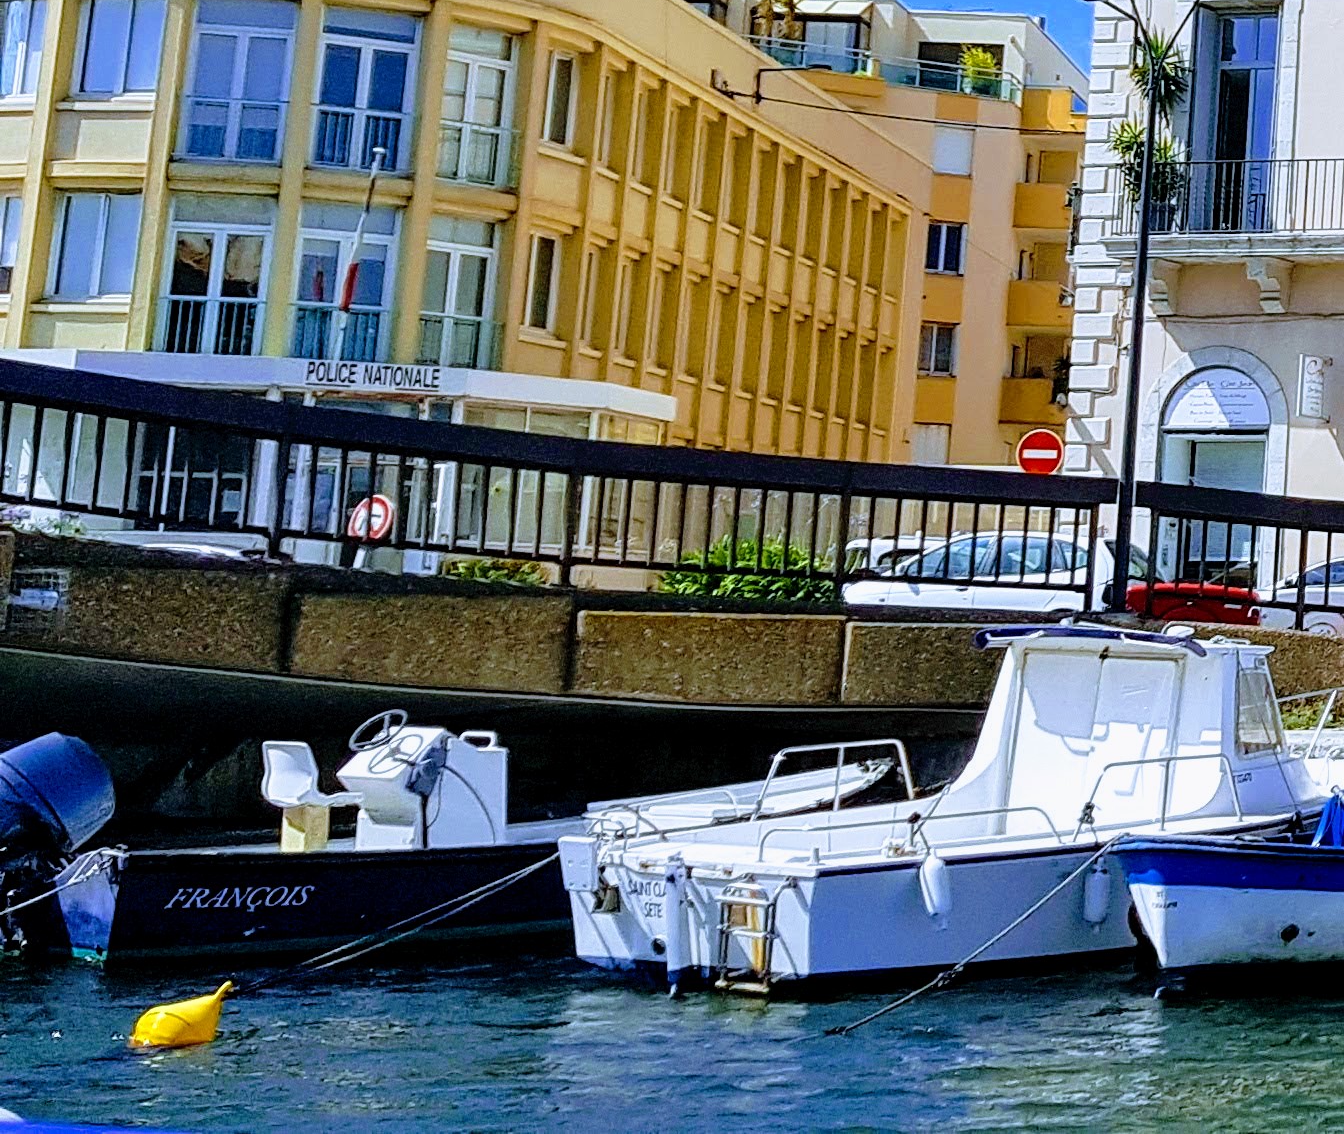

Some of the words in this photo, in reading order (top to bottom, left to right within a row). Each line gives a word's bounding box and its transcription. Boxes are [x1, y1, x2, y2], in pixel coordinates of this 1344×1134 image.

[306, 361, 358, 383] POLICE
[363, 365, 440, 388] NATIONALE
[164, 885, 316, 912] FRANÇOIS
